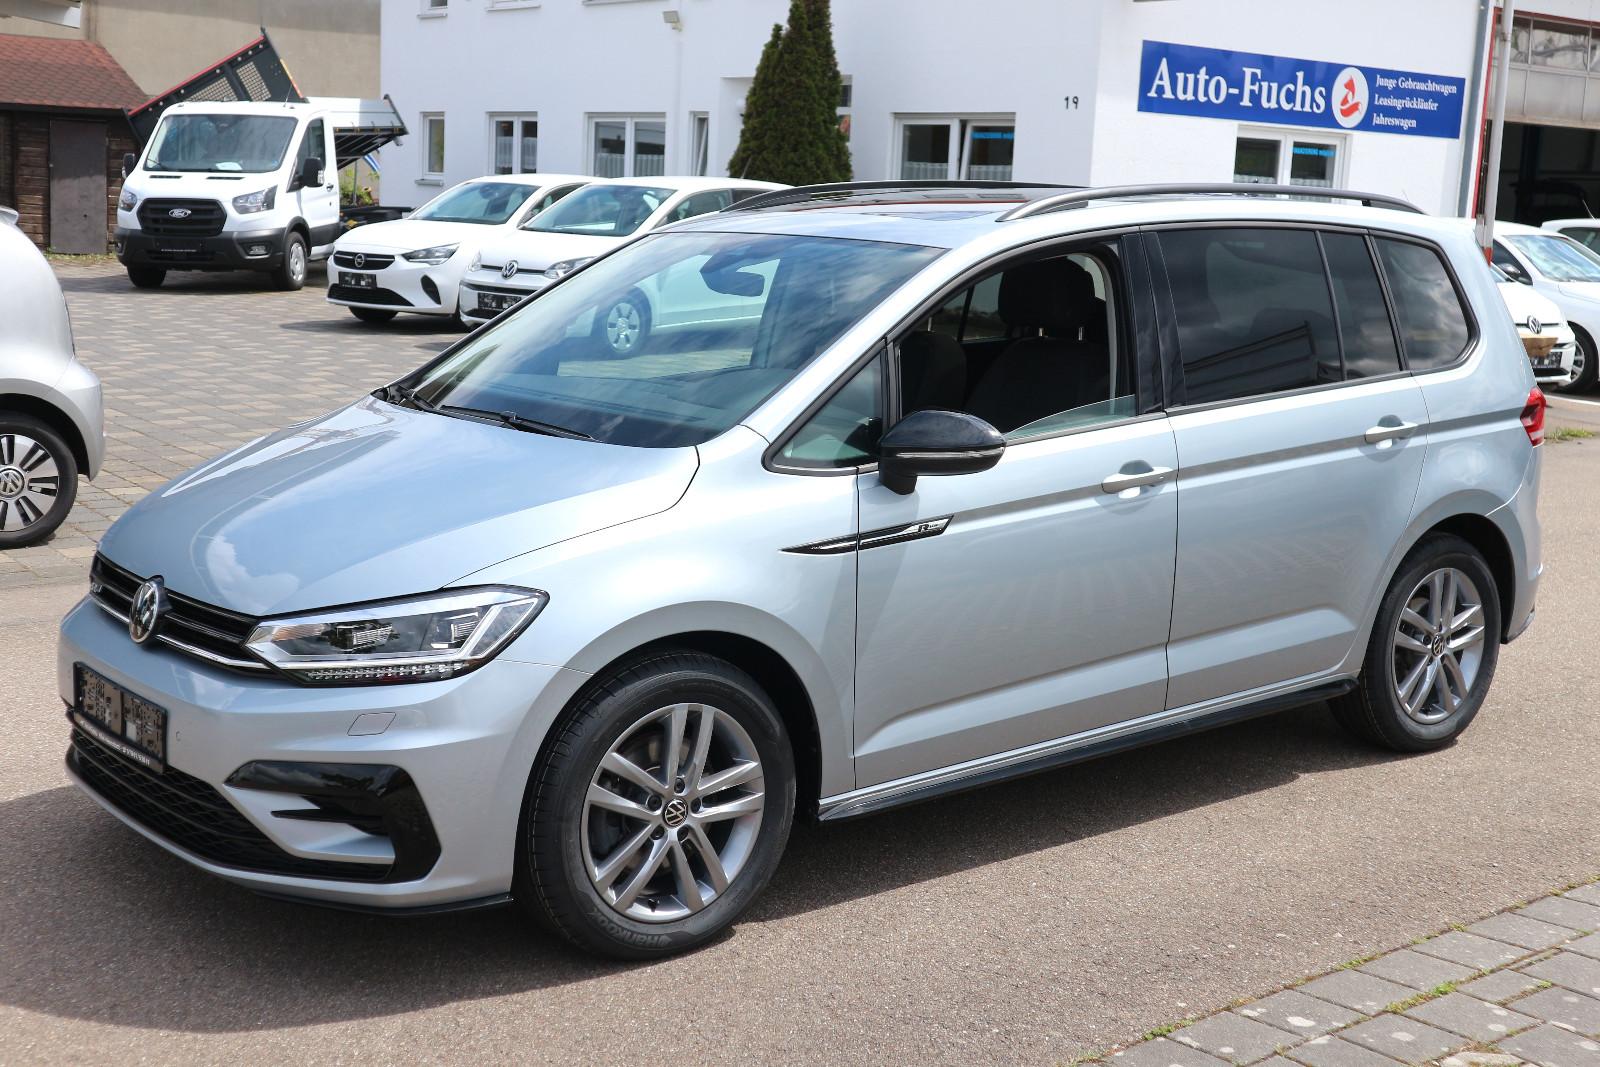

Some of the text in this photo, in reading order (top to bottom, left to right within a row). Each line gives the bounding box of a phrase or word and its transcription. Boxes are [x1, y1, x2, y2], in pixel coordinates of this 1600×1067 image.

[1147, 57, 1326, 114] Auto-Fuchs
[1376, 74, 1457, 96] Junge Gebrauchtwagen
[1064, 95, 1079, 110] 19
[1374, 93, 1439, 111] Leasingrückläufer
[1372, 112, 1417, 130] Jahreswagen
